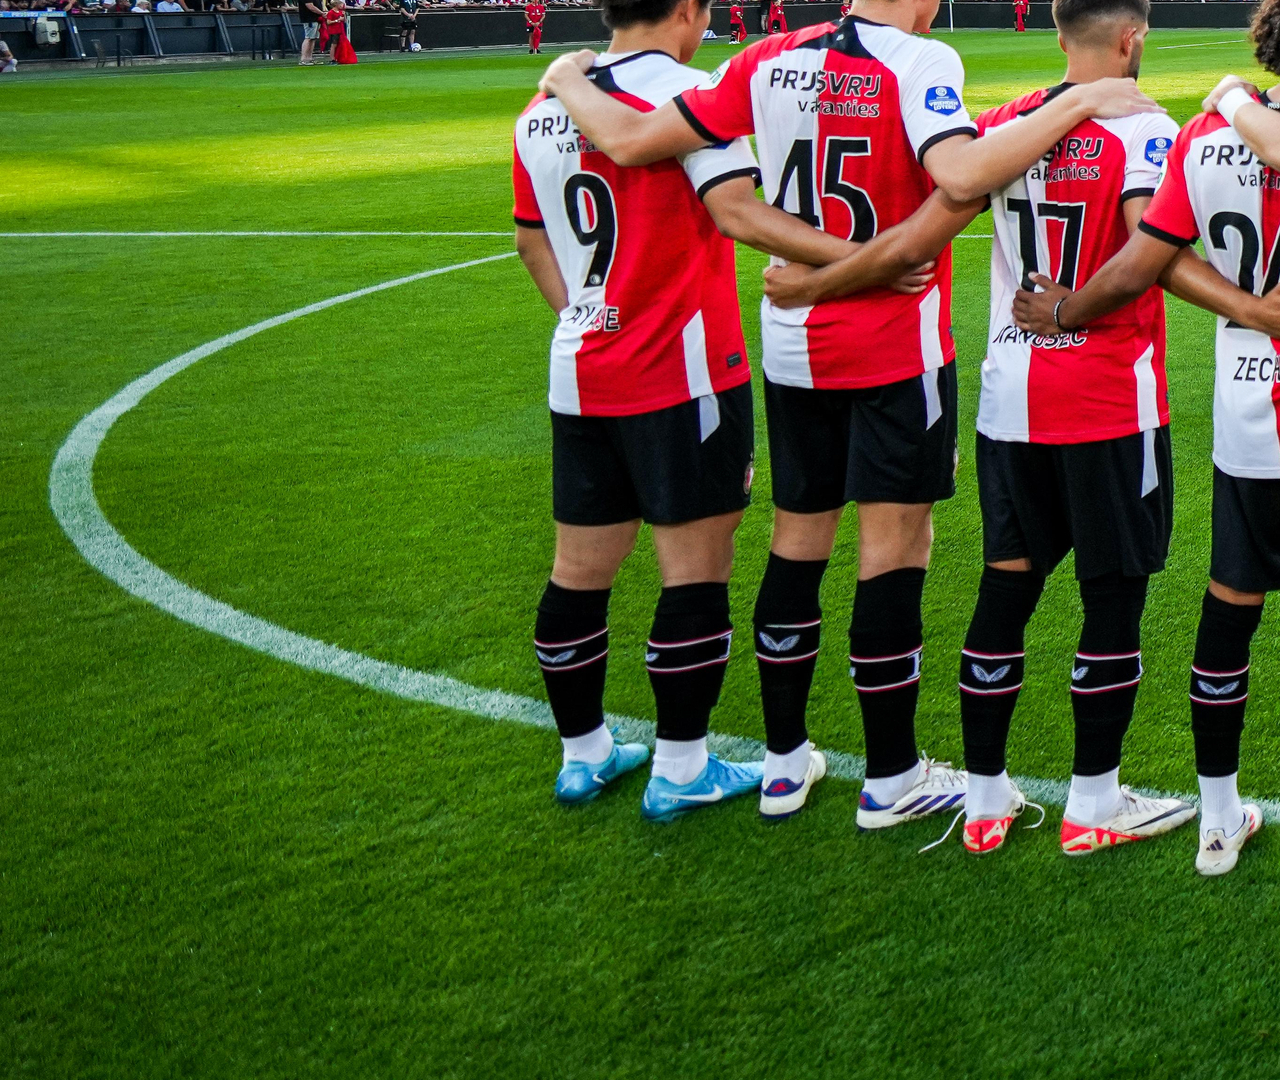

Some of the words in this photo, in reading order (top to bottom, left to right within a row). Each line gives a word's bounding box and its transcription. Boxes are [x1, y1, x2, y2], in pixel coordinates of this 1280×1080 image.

[766, 137, 877, 242] 45
[1031, 165, 1101, 183] akanties
[563, 171, 618, 289] 9
[1006, 197, 1087, 292] 17
